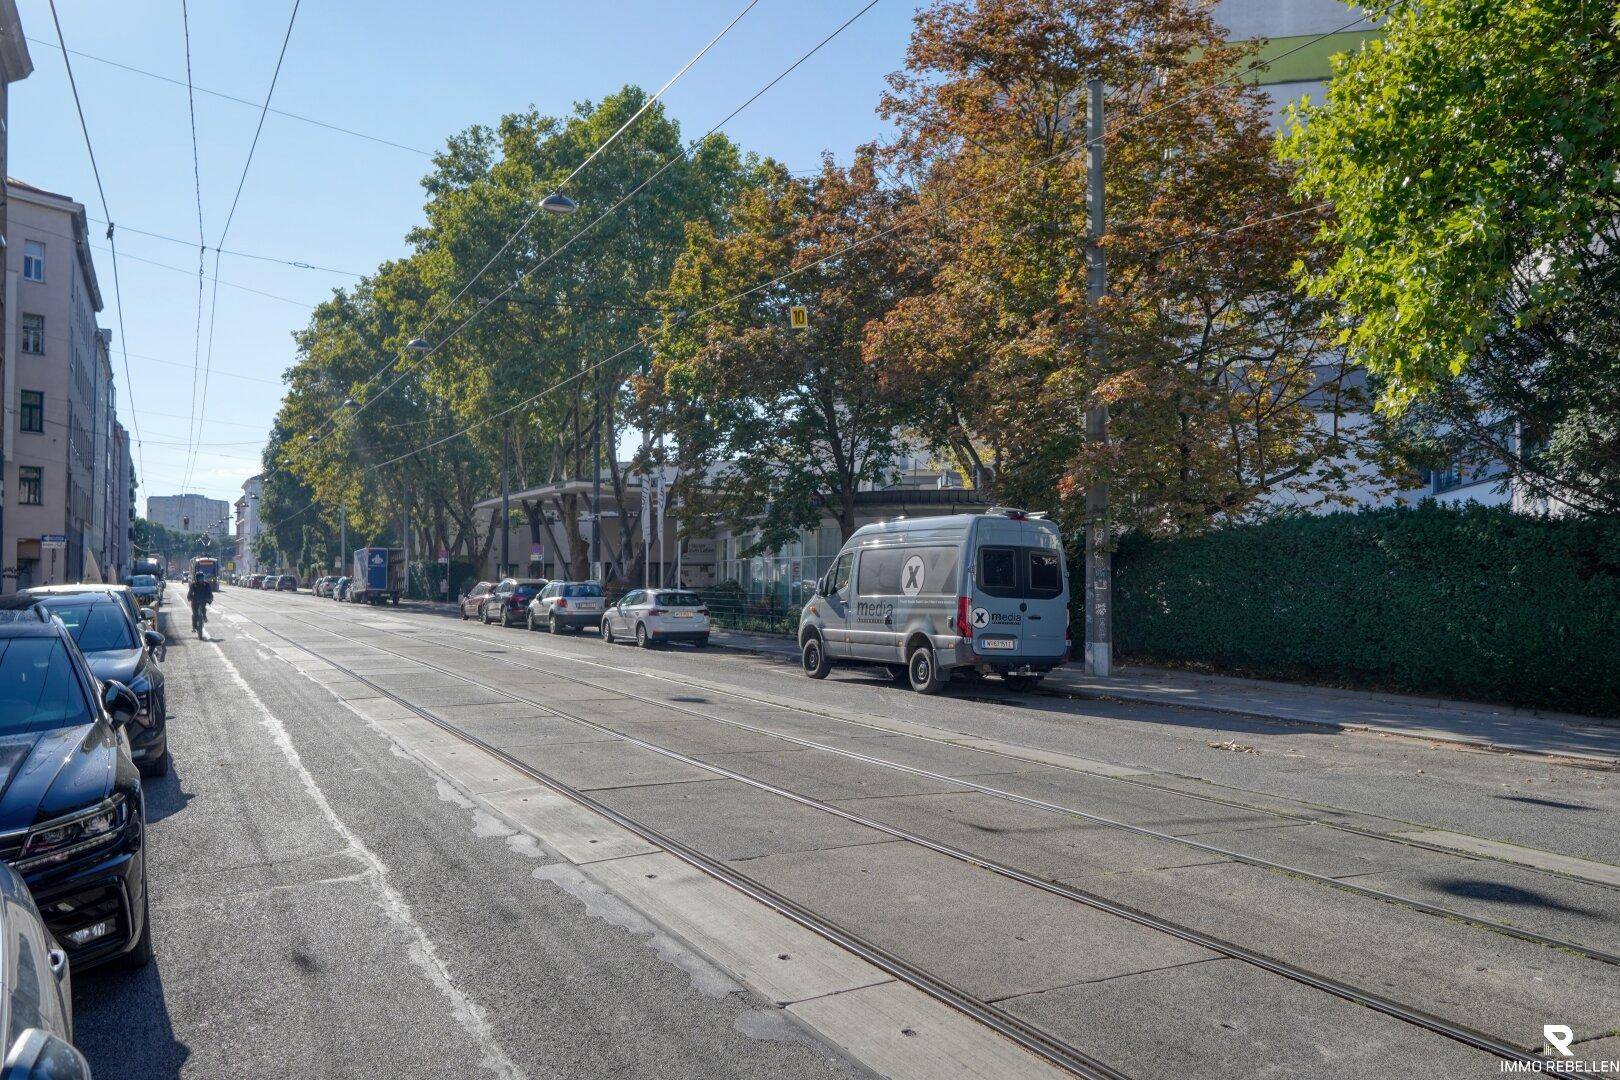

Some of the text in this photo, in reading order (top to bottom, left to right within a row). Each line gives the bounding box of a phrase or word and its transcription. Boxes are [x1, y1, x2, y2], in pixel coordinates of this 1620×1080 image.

[793, 309, 805, 325] 10
[905, 566, 921, 588] X
[857, 599, 893, 617] media
[974, 612, 986, 624] X
[991, 611, 1021, 622] media
